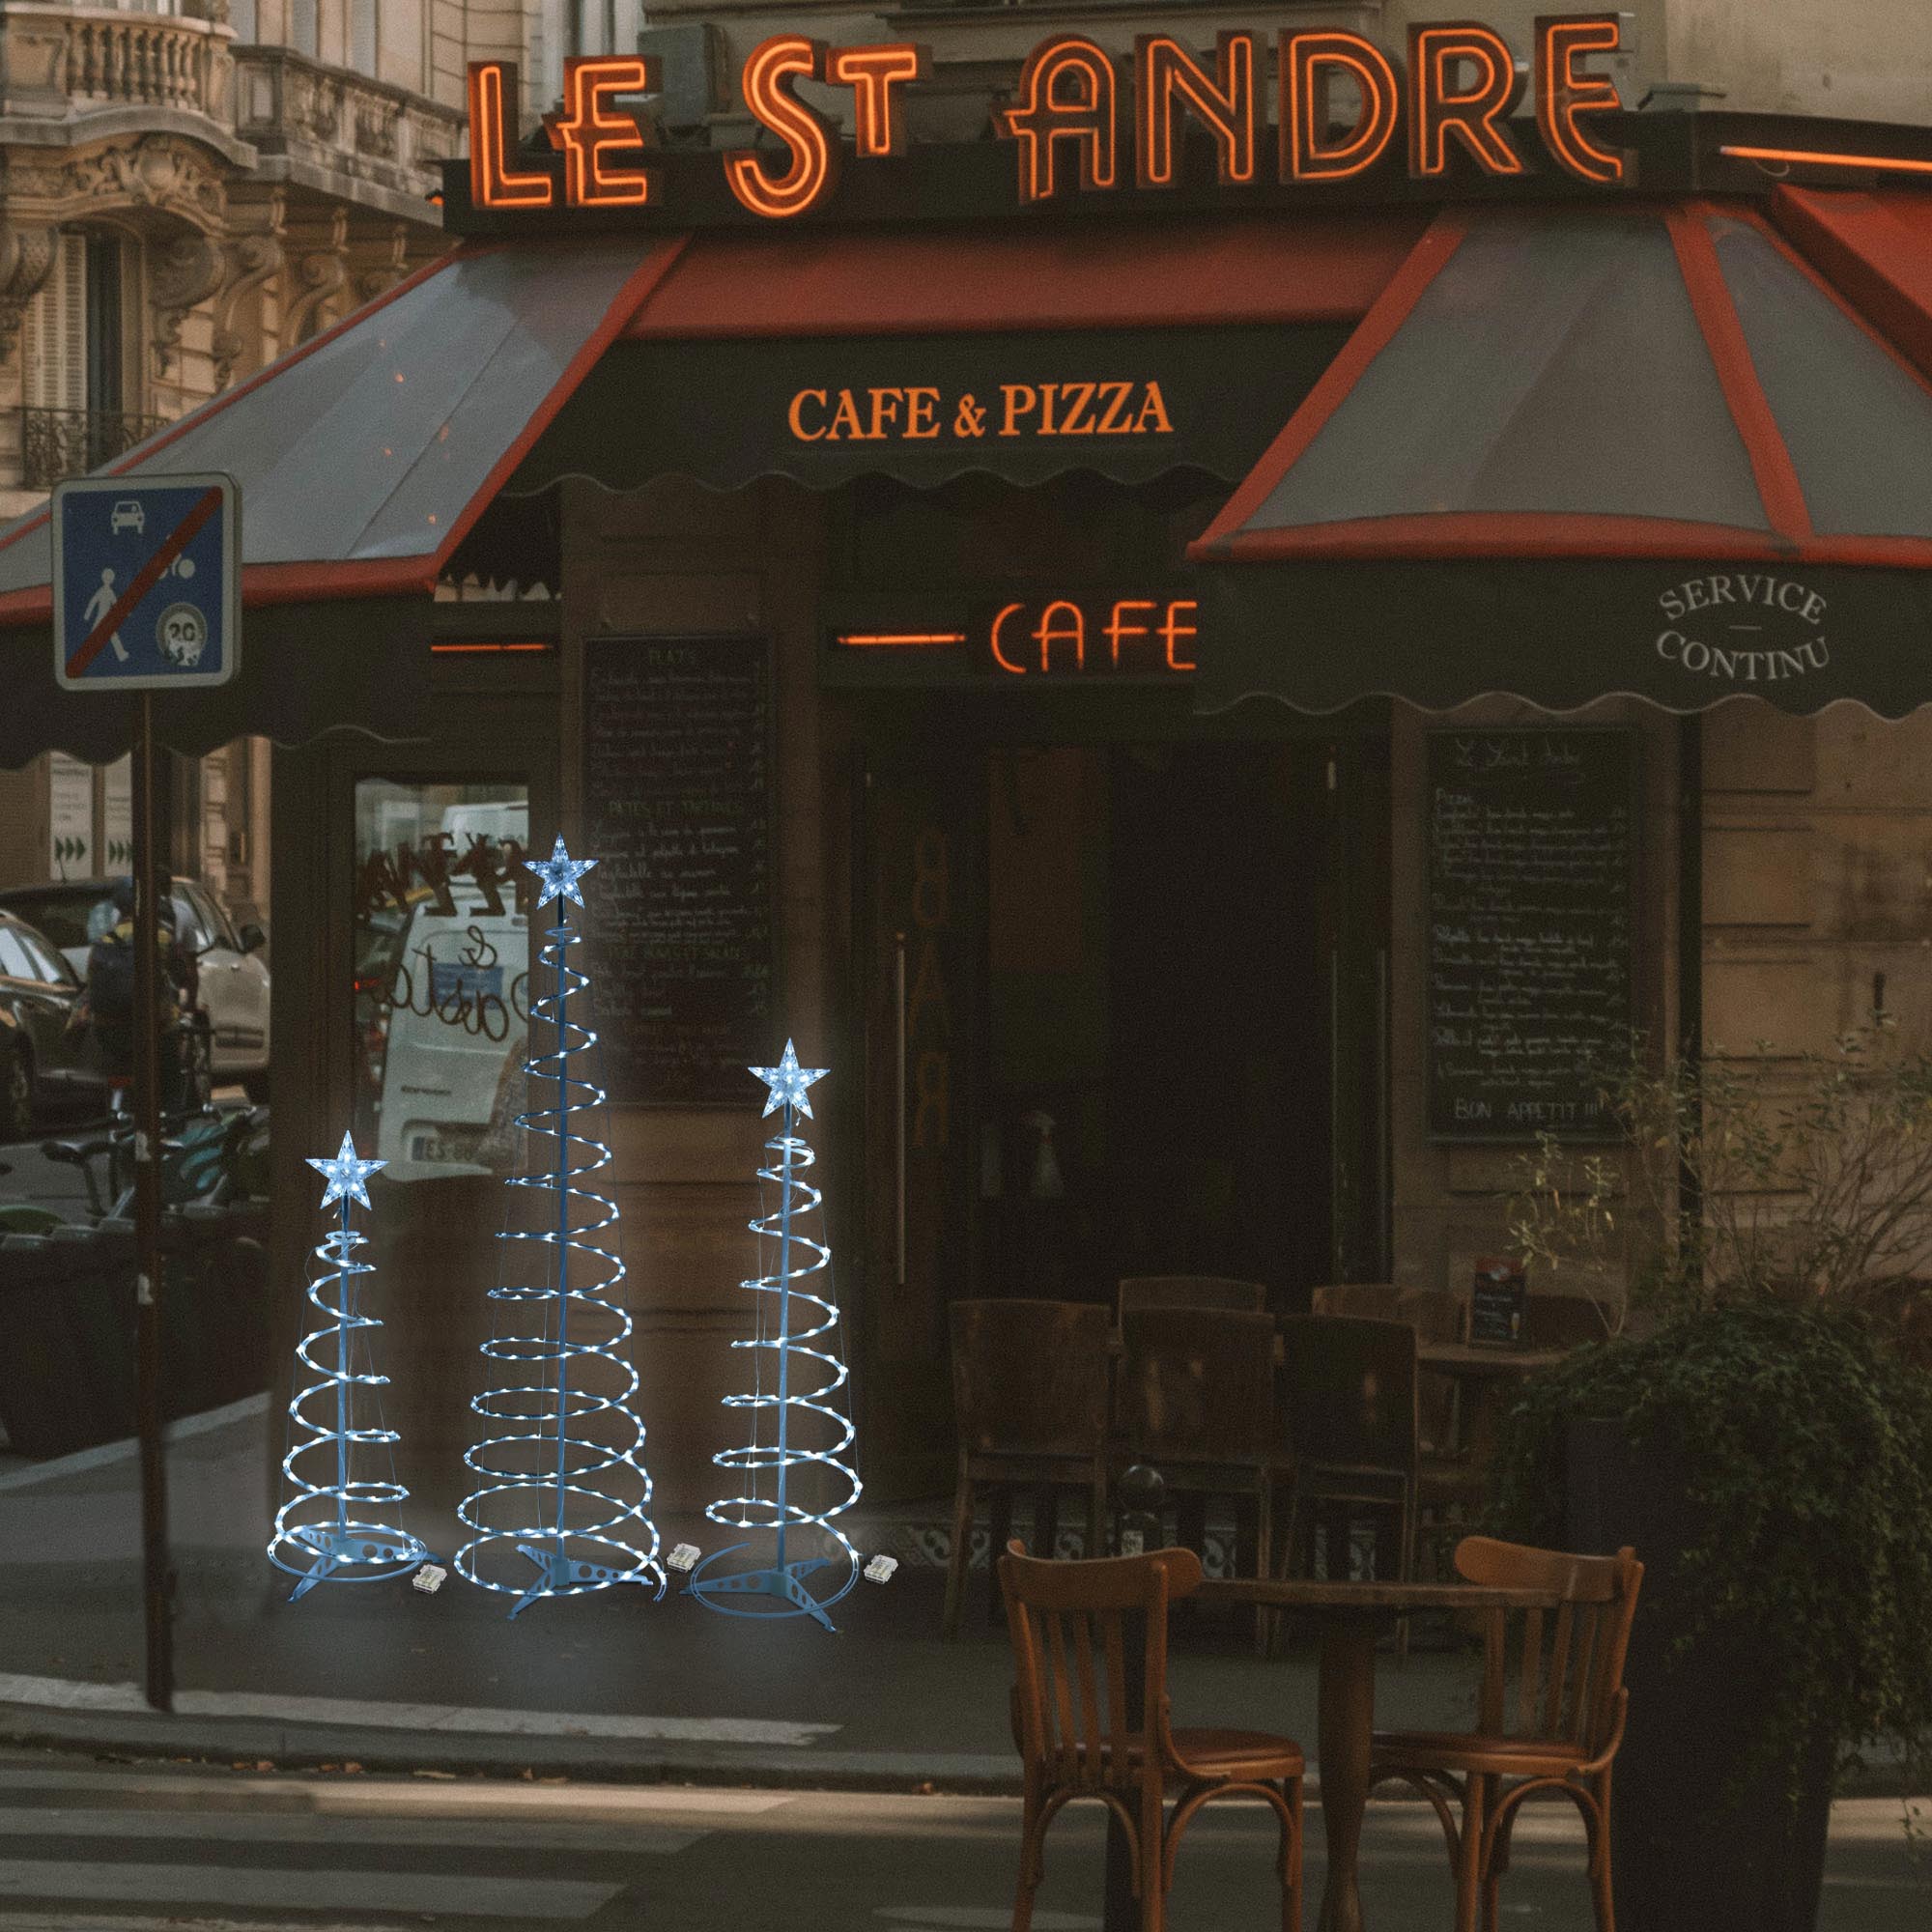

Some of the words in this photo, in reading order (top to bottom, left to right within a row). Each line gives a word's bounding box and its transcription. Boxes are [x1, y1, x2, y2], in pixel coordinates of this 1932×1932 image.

[469, 56, 649, 208] LE
[994, 14, 1625, 204] ANDRE
[788, 387, 942, 440] CAFE
[952, 392, 987, 439] &
[998, 381, 1175, 437] PIZZA
[1658, 574, 1828, 625] SERVICE
[990, 600, 1198, 673] CAFE
[1656, 636, 1831, 681] CONTINU
[1455, 1097, 1492, 1119] BON
